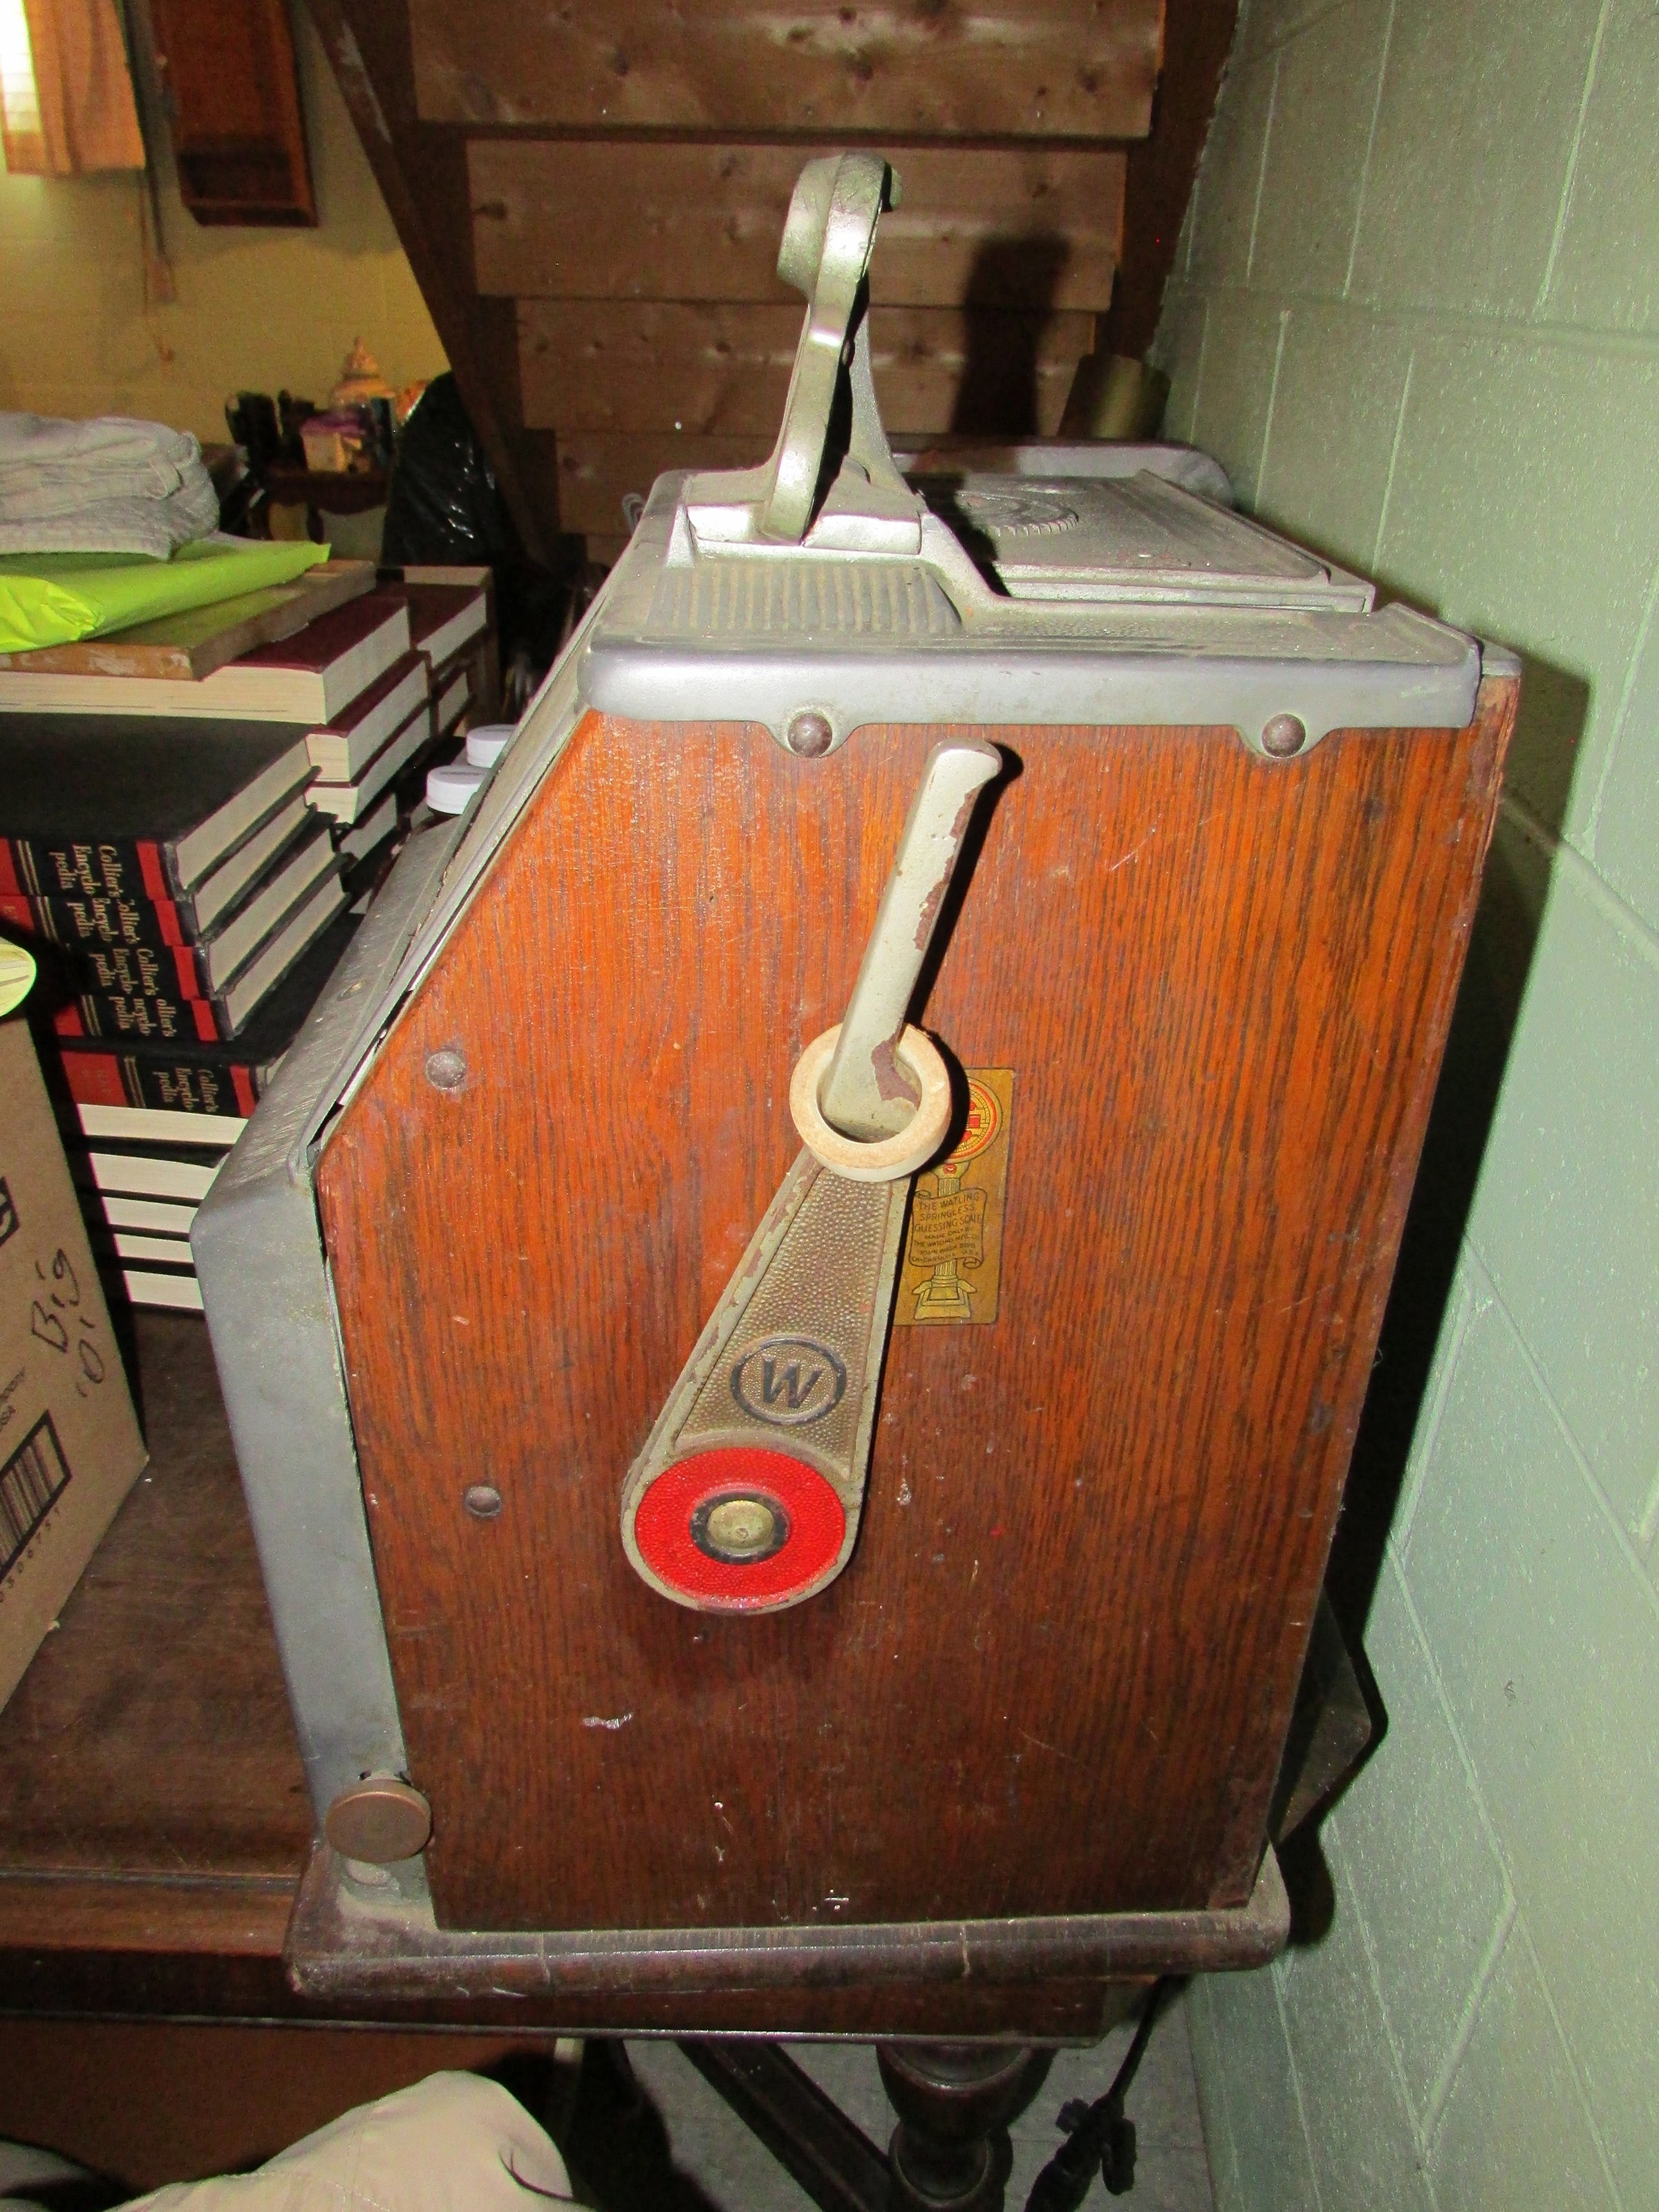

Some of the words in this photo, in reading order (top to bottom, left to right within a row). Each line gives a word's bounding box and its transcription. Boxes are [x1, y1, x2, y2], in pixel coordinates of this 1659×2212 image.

[48, 851, 77, 890] pedia
[99, 845, 124, 898] Collier's
[66, 902, 95, 938] pedia
[88, 953, 116, 988] pedia
[136, 948, 160, 995] Collier's
[108, 996, 134, 1031] pedia
[132, 997, 157, 1036] ncyclo
[156, 998, 177, 1037] ollier's
[151, 1071, 178, 1103] pedia
[197, 1069, 219, 1112] Collier's
[919, 1201, 937, 1210] THE
[940, 1192, 980, 1208] WATLING
[919, 1203, 975, 1221] SPRINGLESS
[915, 1218, 958, 1233] GUESSING
[762, 1352, 824, 1409] W
